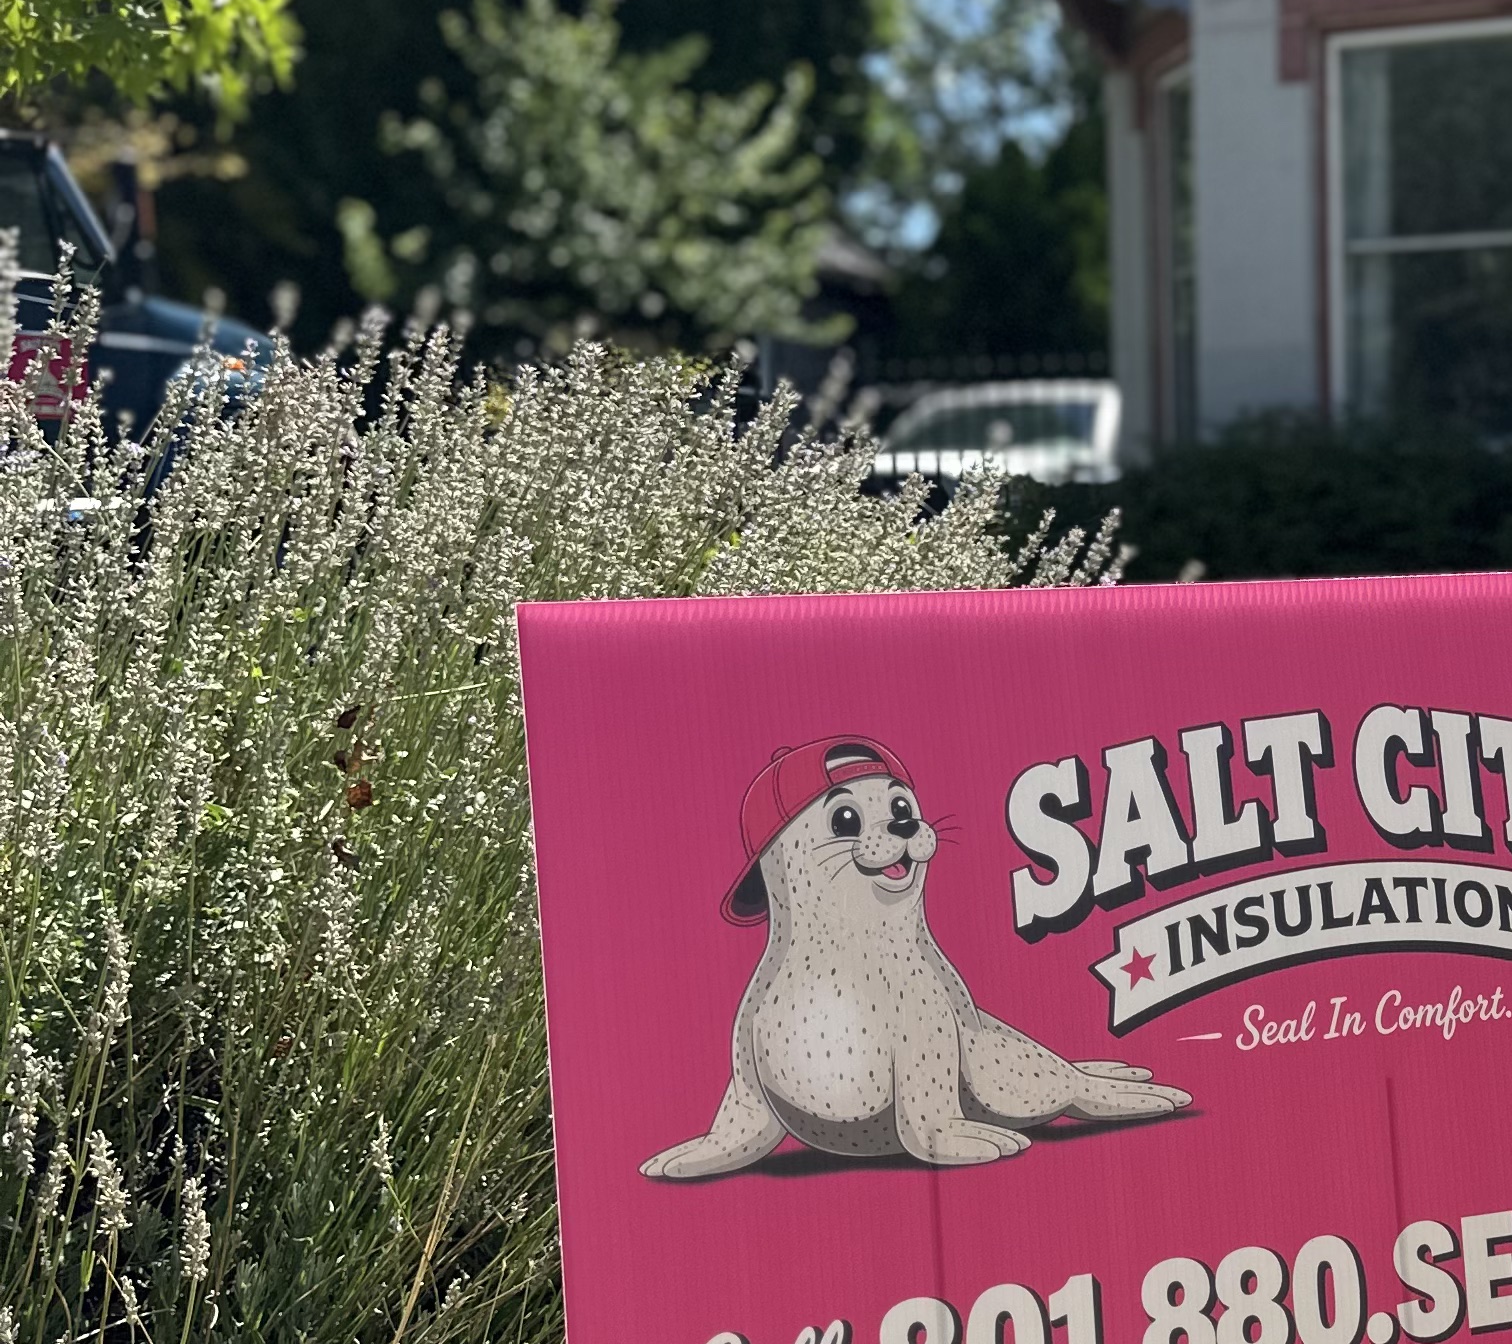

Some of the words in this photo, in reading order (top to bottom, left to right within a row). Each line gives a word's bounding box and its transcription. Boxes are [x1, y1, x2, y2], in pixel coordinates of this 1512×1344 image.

[1006, 709, 1335, 944] SALT
[1236, 1000, 1316, 1050] Seal
[1323, 996, 1366, 1040] In
[1375, 985, 1512, 1040] Comfort.
